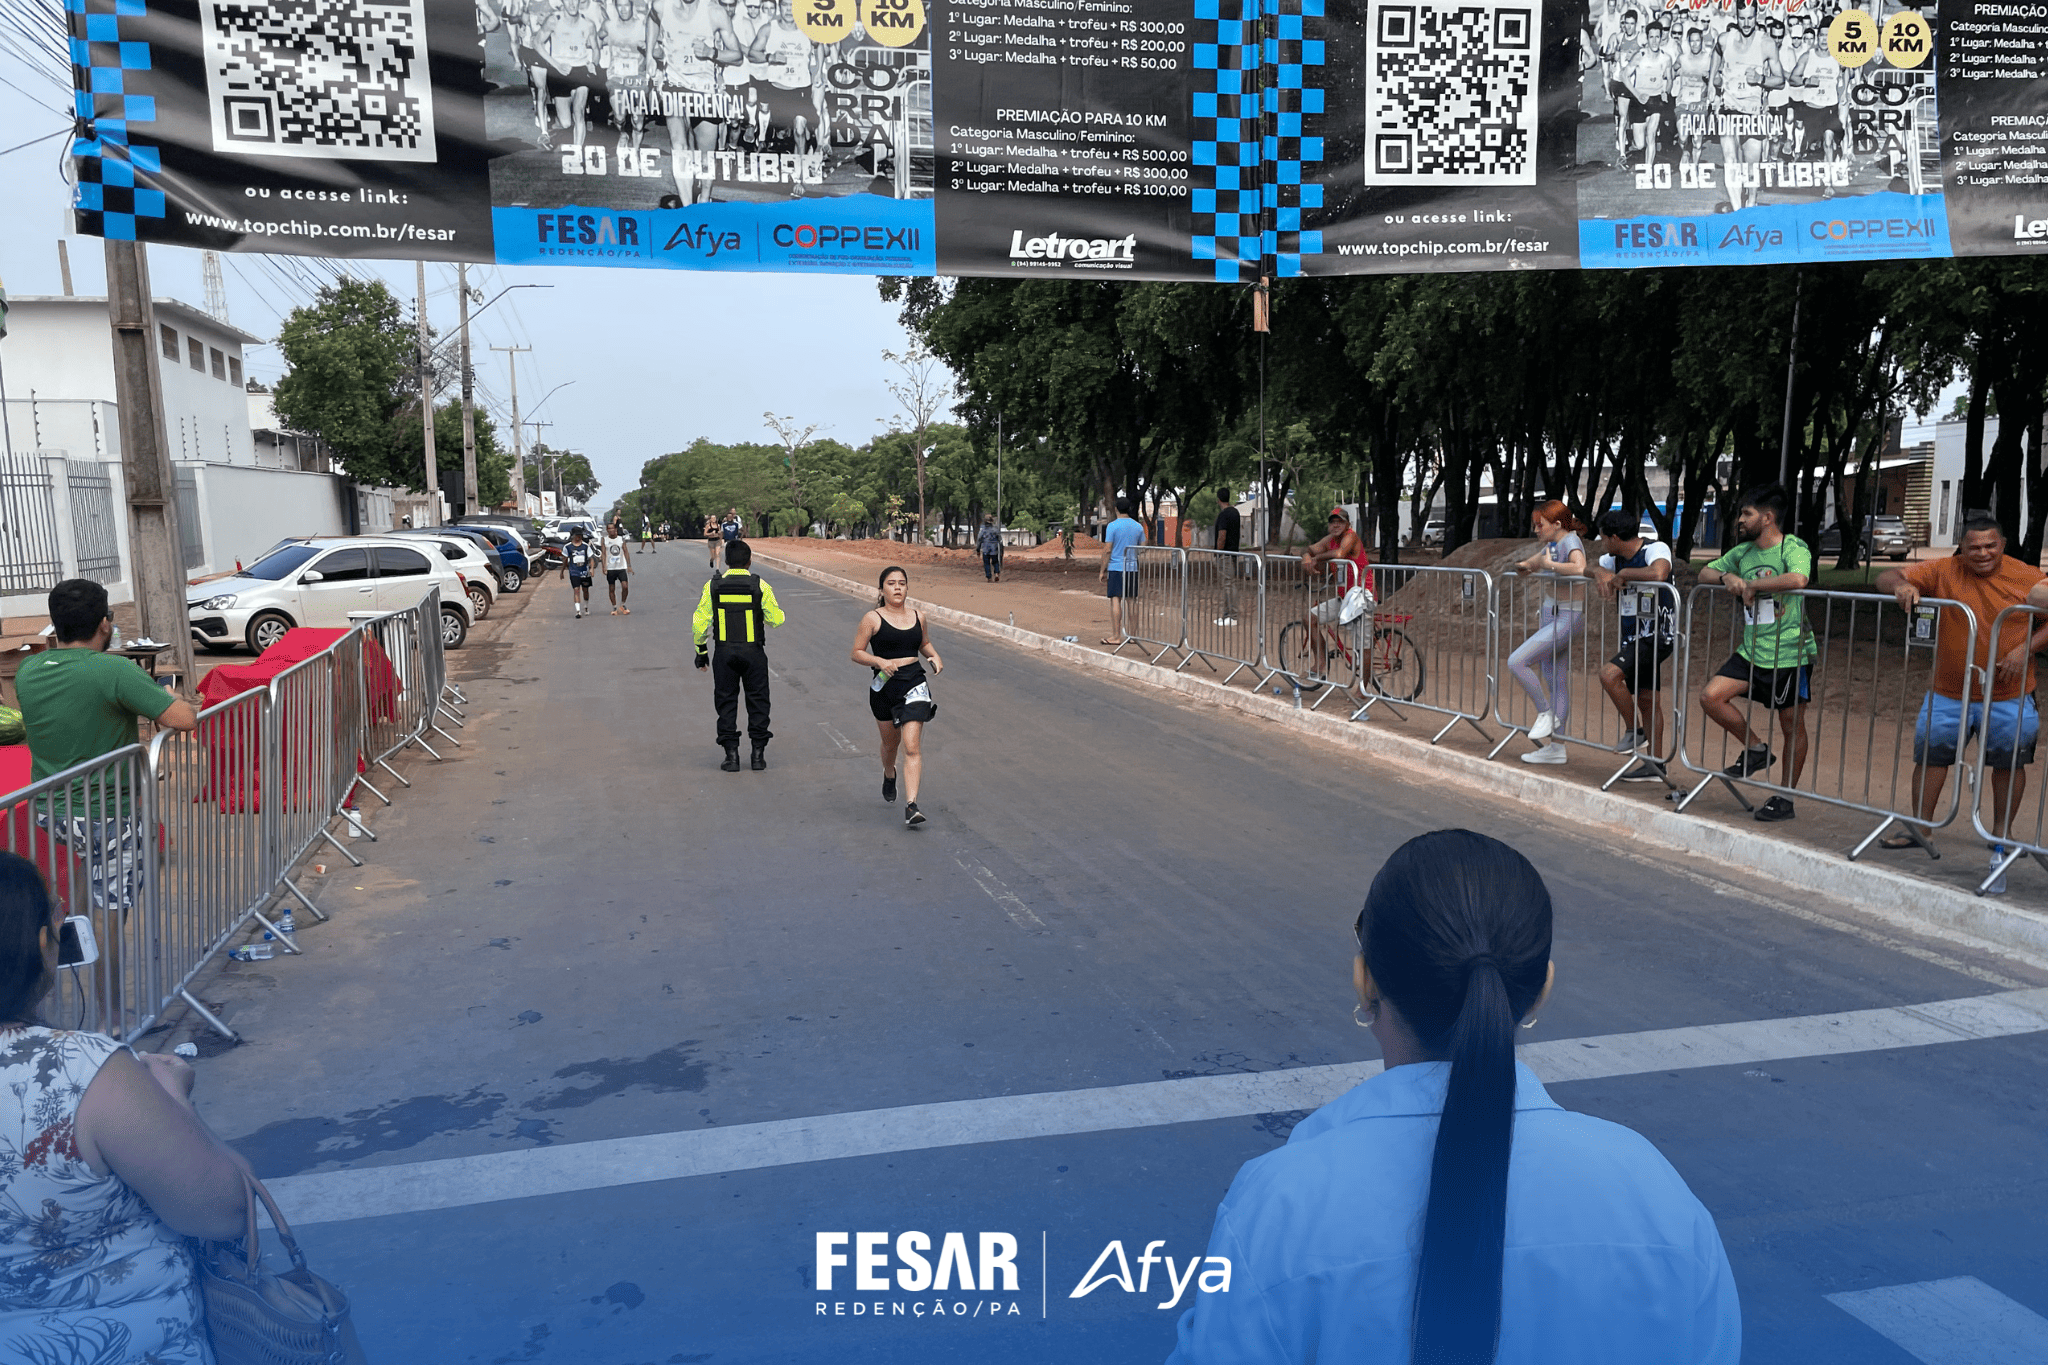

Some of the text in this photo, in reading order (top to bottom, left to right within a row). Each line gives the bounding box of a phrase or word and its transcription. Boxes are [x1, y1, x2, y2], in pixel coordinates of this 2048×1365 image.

[1014, 0, 1133, 14] Masculino/Feminino:
[1974, 3, 2048, 19] PREMIAÇÃO
[807, 13, 843, 27] KM
[871, 11, 914, 29] KM
[948, 12, 960, 23] 1º
[962, 14, 1001, 27] Lugar:
[1004, 15, 1055, 28] Medalha
[1068, 17, 1108, 31] troféu
[1120, 20, 1137, 33] R$
[1140, 22, 1185, 35] 300,00
[1950, 21, 2001, 34] Categoria
[1845, 21, 1862, 39] 5
[1893, 23, 1920, 37] 10
[949, 30, 961, 42] 2º
[964, 32, 1002, 46] Lugar:
[1005, 33, 1056, 47] Medalha
[1069, 37, 1109, 50] troféu
[1112, 40, 1118, 48] +
[1121, 39, 1138, 51] R$
[1140, 40, 1185, 53] 200,00
[1838, 42, 1867, 53] KM
[1889, 39, 1923, 53] KM
[1950, 37, 1960, 47] 1º
[1961, 38, 1992, 50] Lugar:
[1994, 38, 2035, 49] Medalha
[684, 56, 693, 64] 21
[949, 49, 962, 60] 3º
[964, 51, 1002, 64] Lugar:
[1005, 51, 1057, 65] Medalha
[1069, 54, 1109, 68] troféu
[1112, 58, 1119, 66] +
[1121, 57, 1138, 69] R$
[1140, 58, 1177, 70] 50,00
[1950, 53, 1960, 63] 2º
[1962, 54, 1993, 66] Lugar:
[1995, 54, 2037, 64] Medalha
[828, 62, 898, 92] CO
[1950, 68, 1961, 78] 3º
[1962, 69, 1994, 81] Lugar:
[1995, 69, 2038, 79] Medalha
[1851, 84, 1909, 106] CO
[615, 89, 745, 124] FAÇA A DIFERENÇA!
[832, 94, 901, 121] RRI
[997, 108, 1167, 127] PREMIAÇÃO PARA 10 KM
[1680, 114, 1784, 140] FAÇA A DIFERENÇA!
[1852, 110, 1912, 131] RRI
[830, 124, 894, 148] DA
[950, 126, 1136, 144] Categoria Masculino/Feminino:
[1853, 134, 1906, 154] DA
[1953, 131, 2007, 143] Categoria
[950, 142, 963, 154] 1º
[965, 144, 1004, 157] Lugar:
[1006, 145, 1058, 158] Medalha
[1070, 148, 1110, 160] troféu
[1123, 150, 1140, 162] R$
[1142, 150, 1187, 163] 500,00
[1954, 145, 2046, 157] 1º Lugar: Medalha
[561, 144, 823, 184] 20 DE OUTUBRO
[951, 161, 964, 173] 2º
[967, 162, 1005, 175] Lugar:
[1008, 163, 1059, 175] Medalha
[1062, 166, 1070, 174] +
[1072, 166, 1112, 177] troféu
[1124, 167, 1141, 179] R$
[1143, 167, 1188, 181] 300,00
[1956, 160, 2048, 172] 2º Lugar: Medalha
[1635, 162, 1850, 190] 20 DE OUTUBRO
[1957, 174, 2048, 187] 3º Lugar: Medalha
[245, 187, 409, 205] ou acesse link:
[952, 179, 964, 190] 3º
[967, 180, 1006, 193] Lugar:
[1008, 180, 1059, 193] Medalha
[1072, 183, 1112, 195] troféu
[1124, 184, 1141, 196] R$
[1143, 185, 1187, 198] 100,00
[186, 212, 456, 241] www.topchip.com.br/fesar
[1385, 210, 1513, 224] ou acesse link:
[537, 214, 639, 246] FESAR
[1615, 222, 1698, 249] FESAR
[1810, 219, 1936, 241] COPPEXII
[2014, 215, 2048, 239] Le
[664, 223, 741, 257] Afya
[773, 224, 920, 251] COPPEXII
[1010, 230, 1137, 259] Letroart
[1718, 225, 1783, 252] Afya
[540, 248, 640, 258] REDENÇÃO/PA
[1338, 238, 1550, 257] www.topchip.com.br/fesar
[1074, 262, 1114, 270] comunicação
